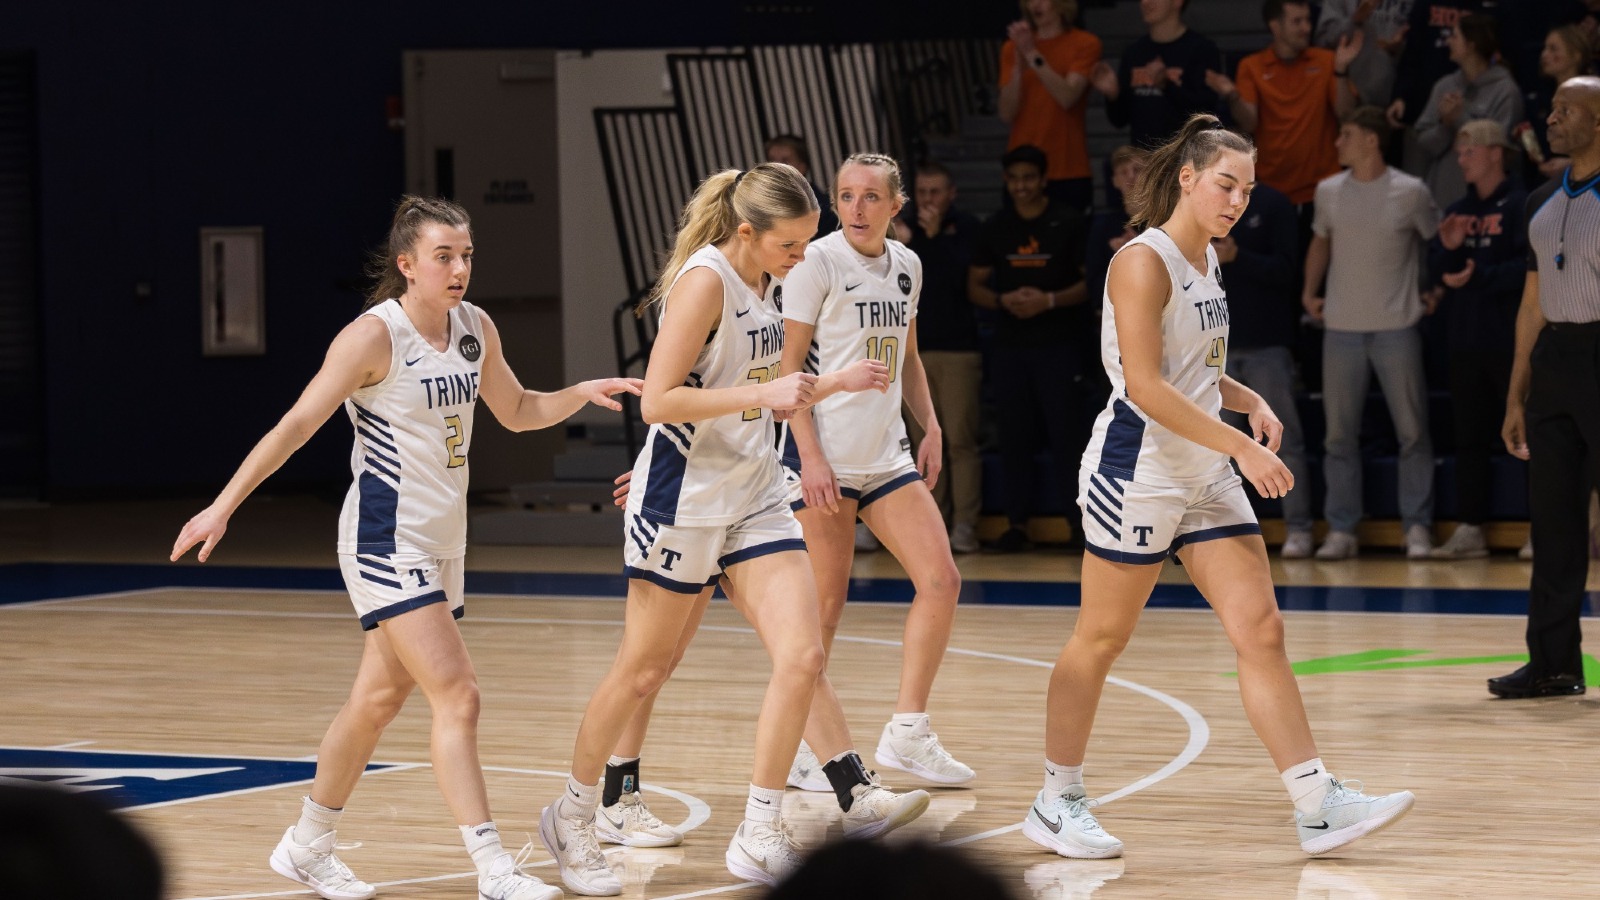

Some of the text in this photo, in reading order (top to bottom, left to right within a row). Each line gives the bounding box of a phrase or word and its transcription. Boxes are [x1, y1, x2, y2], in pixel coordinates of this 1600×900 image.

[855, 301, 907, 328] TRINE
[866, 336, 898, 383] 10
[1205, 336, 1226, 382] 4
[420, 371, 478, 409] TRINE
[444, 414, 466, 468] 2
[1133, 526, 1153, 547] T
[660, 547, 681, 572] T
[409, 568, 429, 588] T
